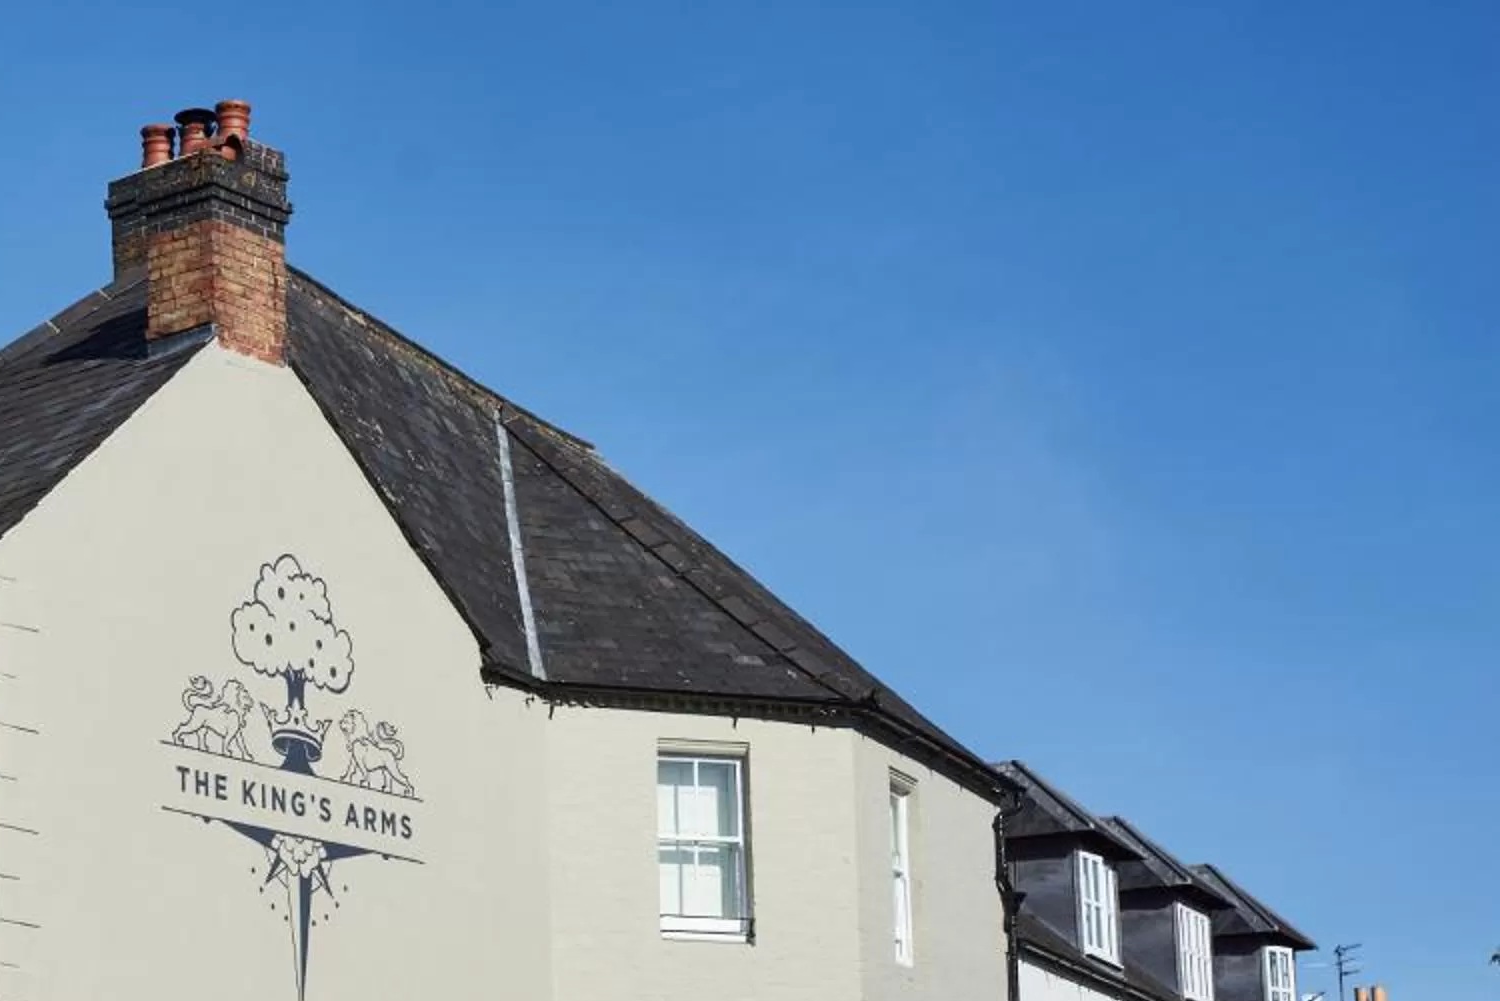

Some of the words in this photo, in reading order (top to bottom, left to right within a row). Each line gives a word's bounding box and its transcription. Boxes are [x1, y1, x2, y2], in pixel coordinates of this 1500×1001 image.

[176, 766, 228, 800] THE
[241, 779, 331, 822] KING'S
[345, 803, 413, 839] ARMS
